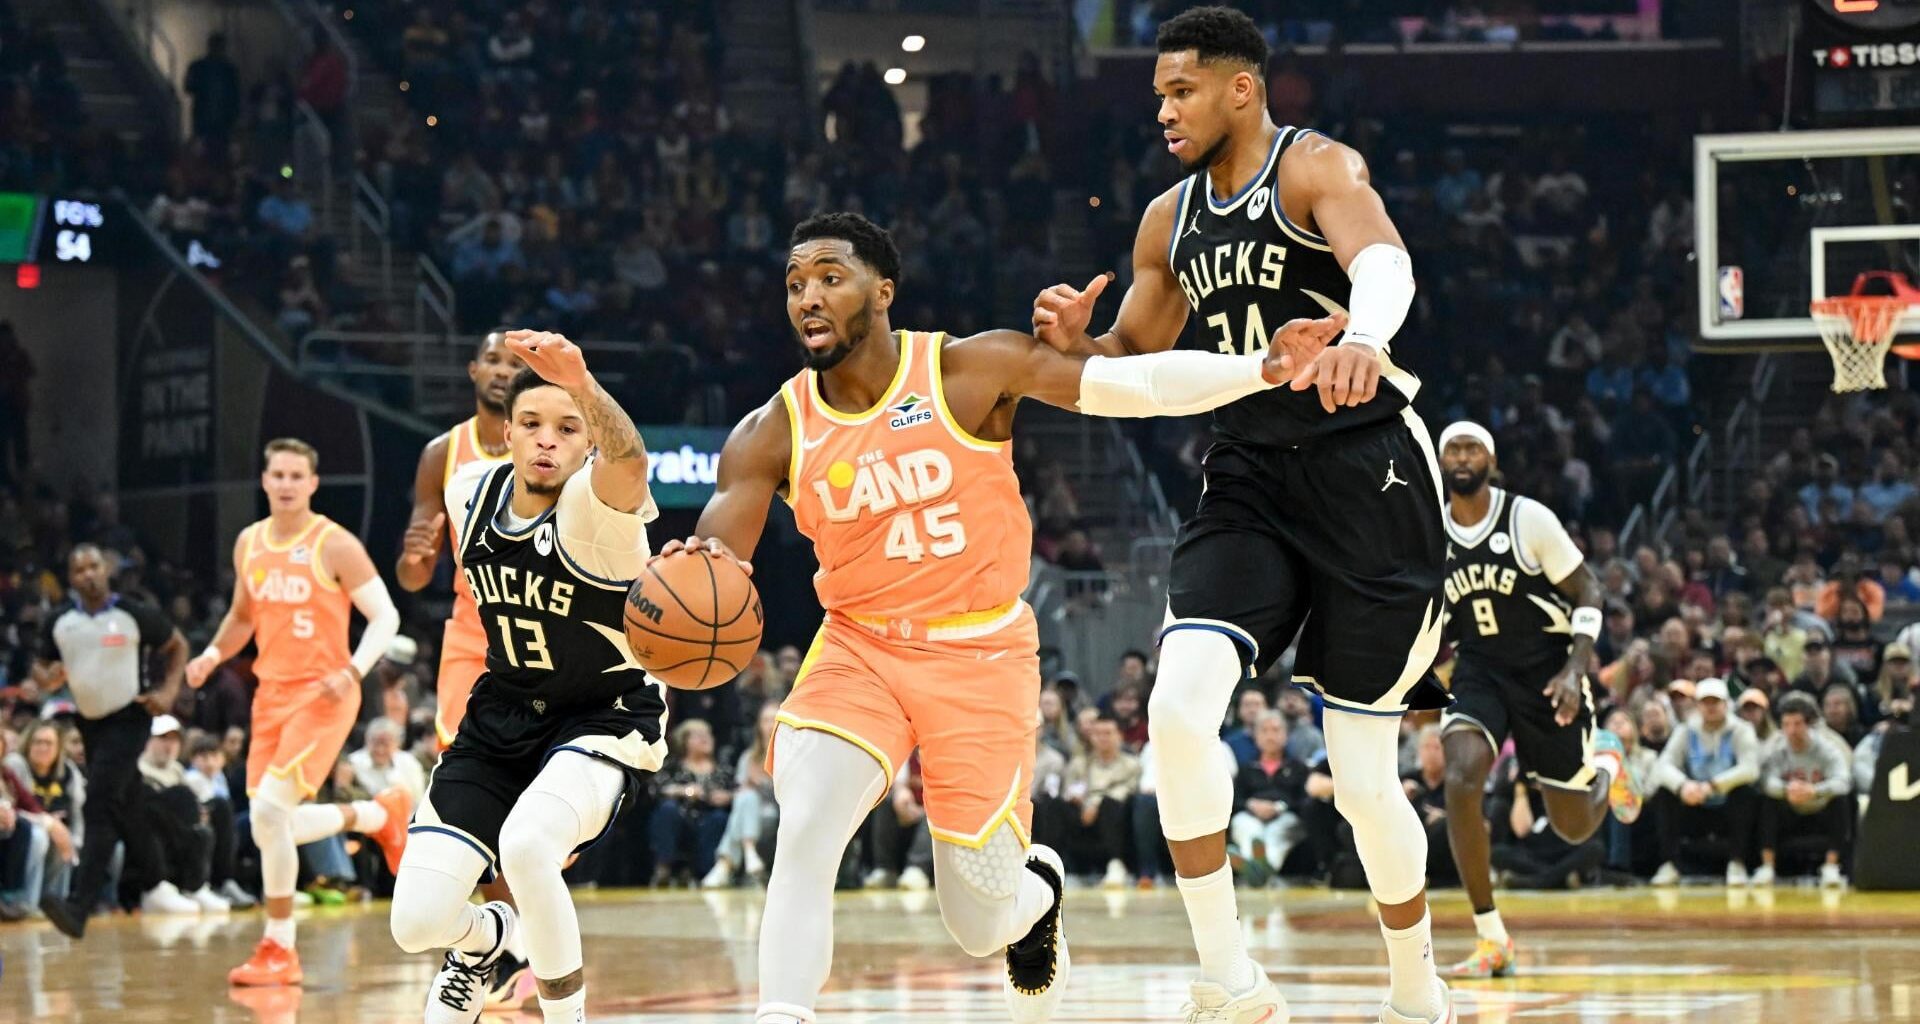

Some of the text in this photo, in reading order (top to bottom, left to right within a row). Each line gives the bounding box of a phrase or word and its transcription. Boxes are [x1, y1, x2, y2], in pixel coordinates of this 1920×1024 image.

[1851, 42, 1920, 67] TISS
[56, 229, 92, 262] 54
[1178, 240, 1288, 313] BUCKS
[1206, 302, 1270, 356] 34
[891, 411, 933, 429] CLIFFS
[857, 449, 886, 466] THE
[812, 448, 954, 524] LAND
[884, 501, 968, 564] 45
[464, 563, 575, 617] BUCKS
[1444, 563, 1518, 604] BUCKS
[292, 608, 316, 640] 5
[1471, 597, 1500, 637] 9
[496, 614, 555, 671] 13
